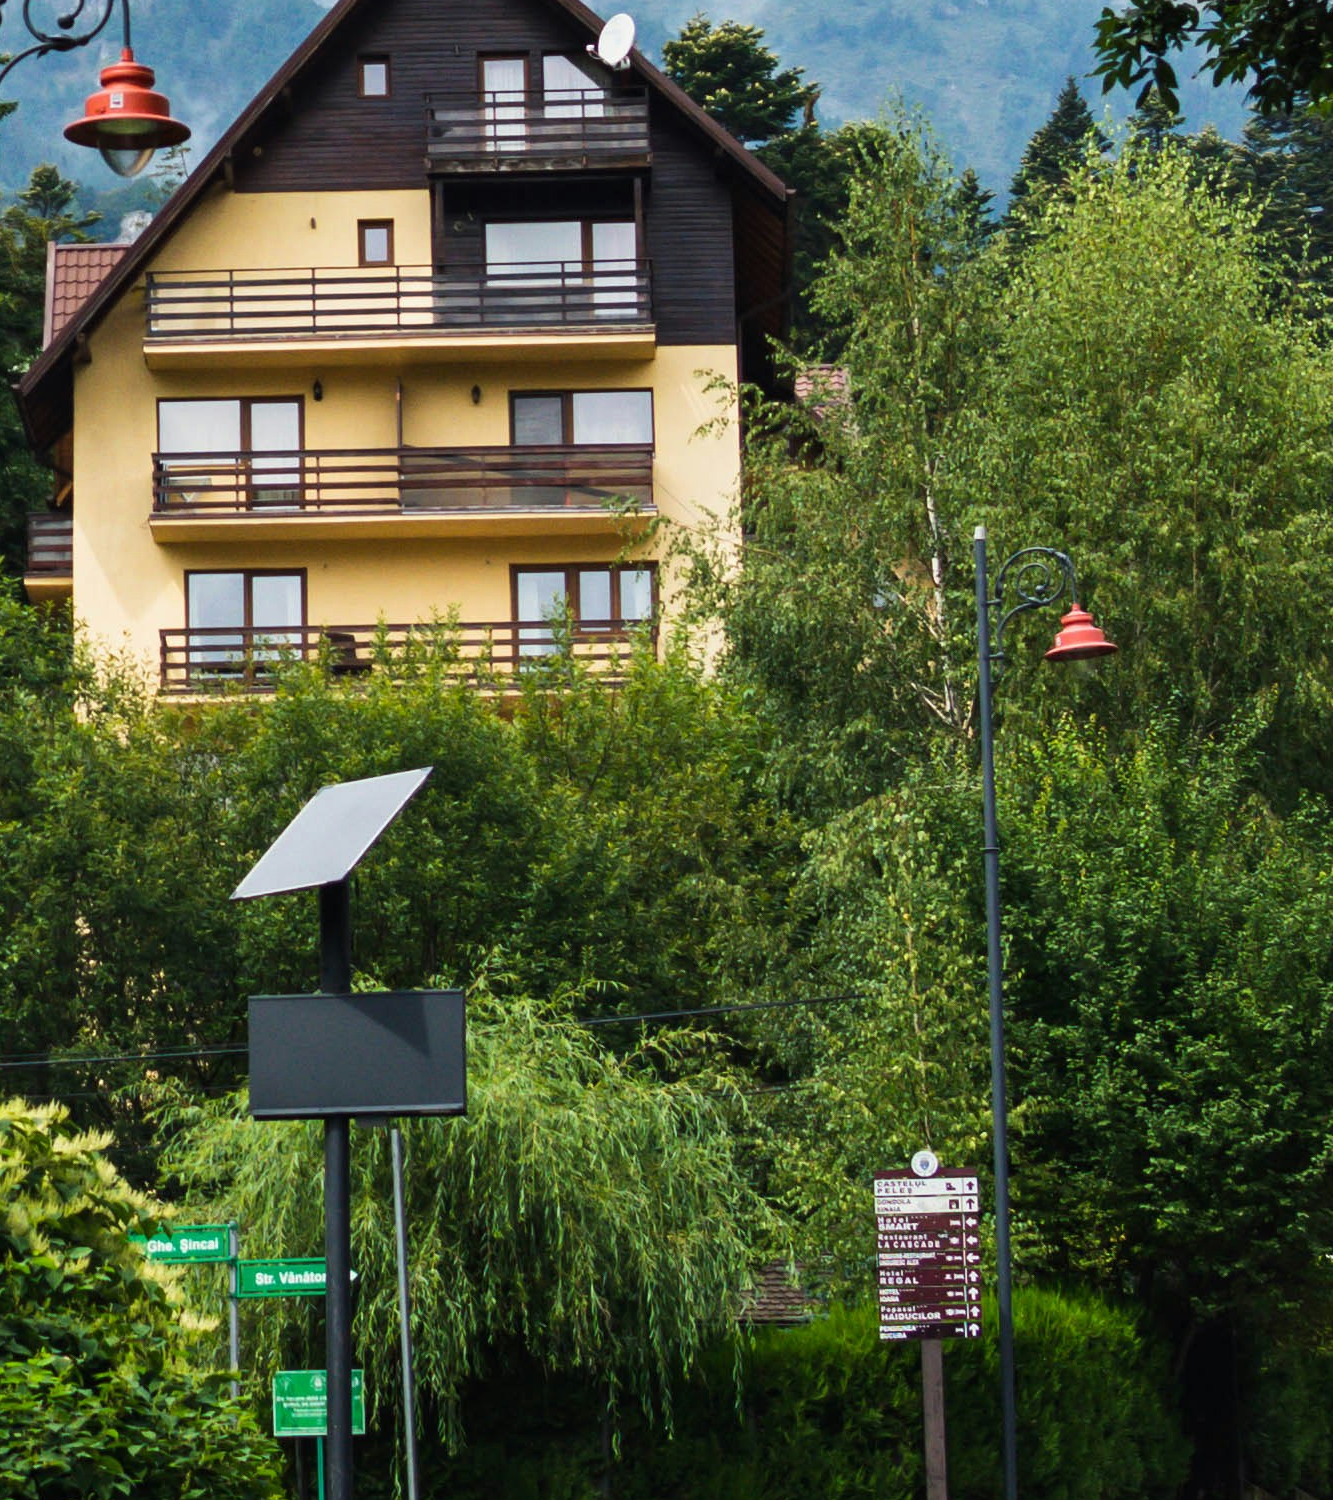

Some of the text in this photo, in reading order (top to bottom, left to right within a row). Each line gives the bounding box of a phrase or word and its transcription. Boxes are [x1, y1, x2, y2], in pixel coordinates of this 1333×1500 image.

[876, 1180, 926, 1188] CASTELUL
[877, 1216, 909, 1224] Hotel
[878, 1222, 920, 1231] SMART
[877, 1233, 928, 1241] Restaurant
[147, 1239, 177, 1253] Ghe.
[877, 1240, 941, 1249] LA CASCADE
[879, 1269, 904, 1277] Hotel
[255, 1272, 277, 1286] Str.
[879, 1276, 919, 1285] REGAL
[880, 1311, 941, 1321] HAIDUCILOR
